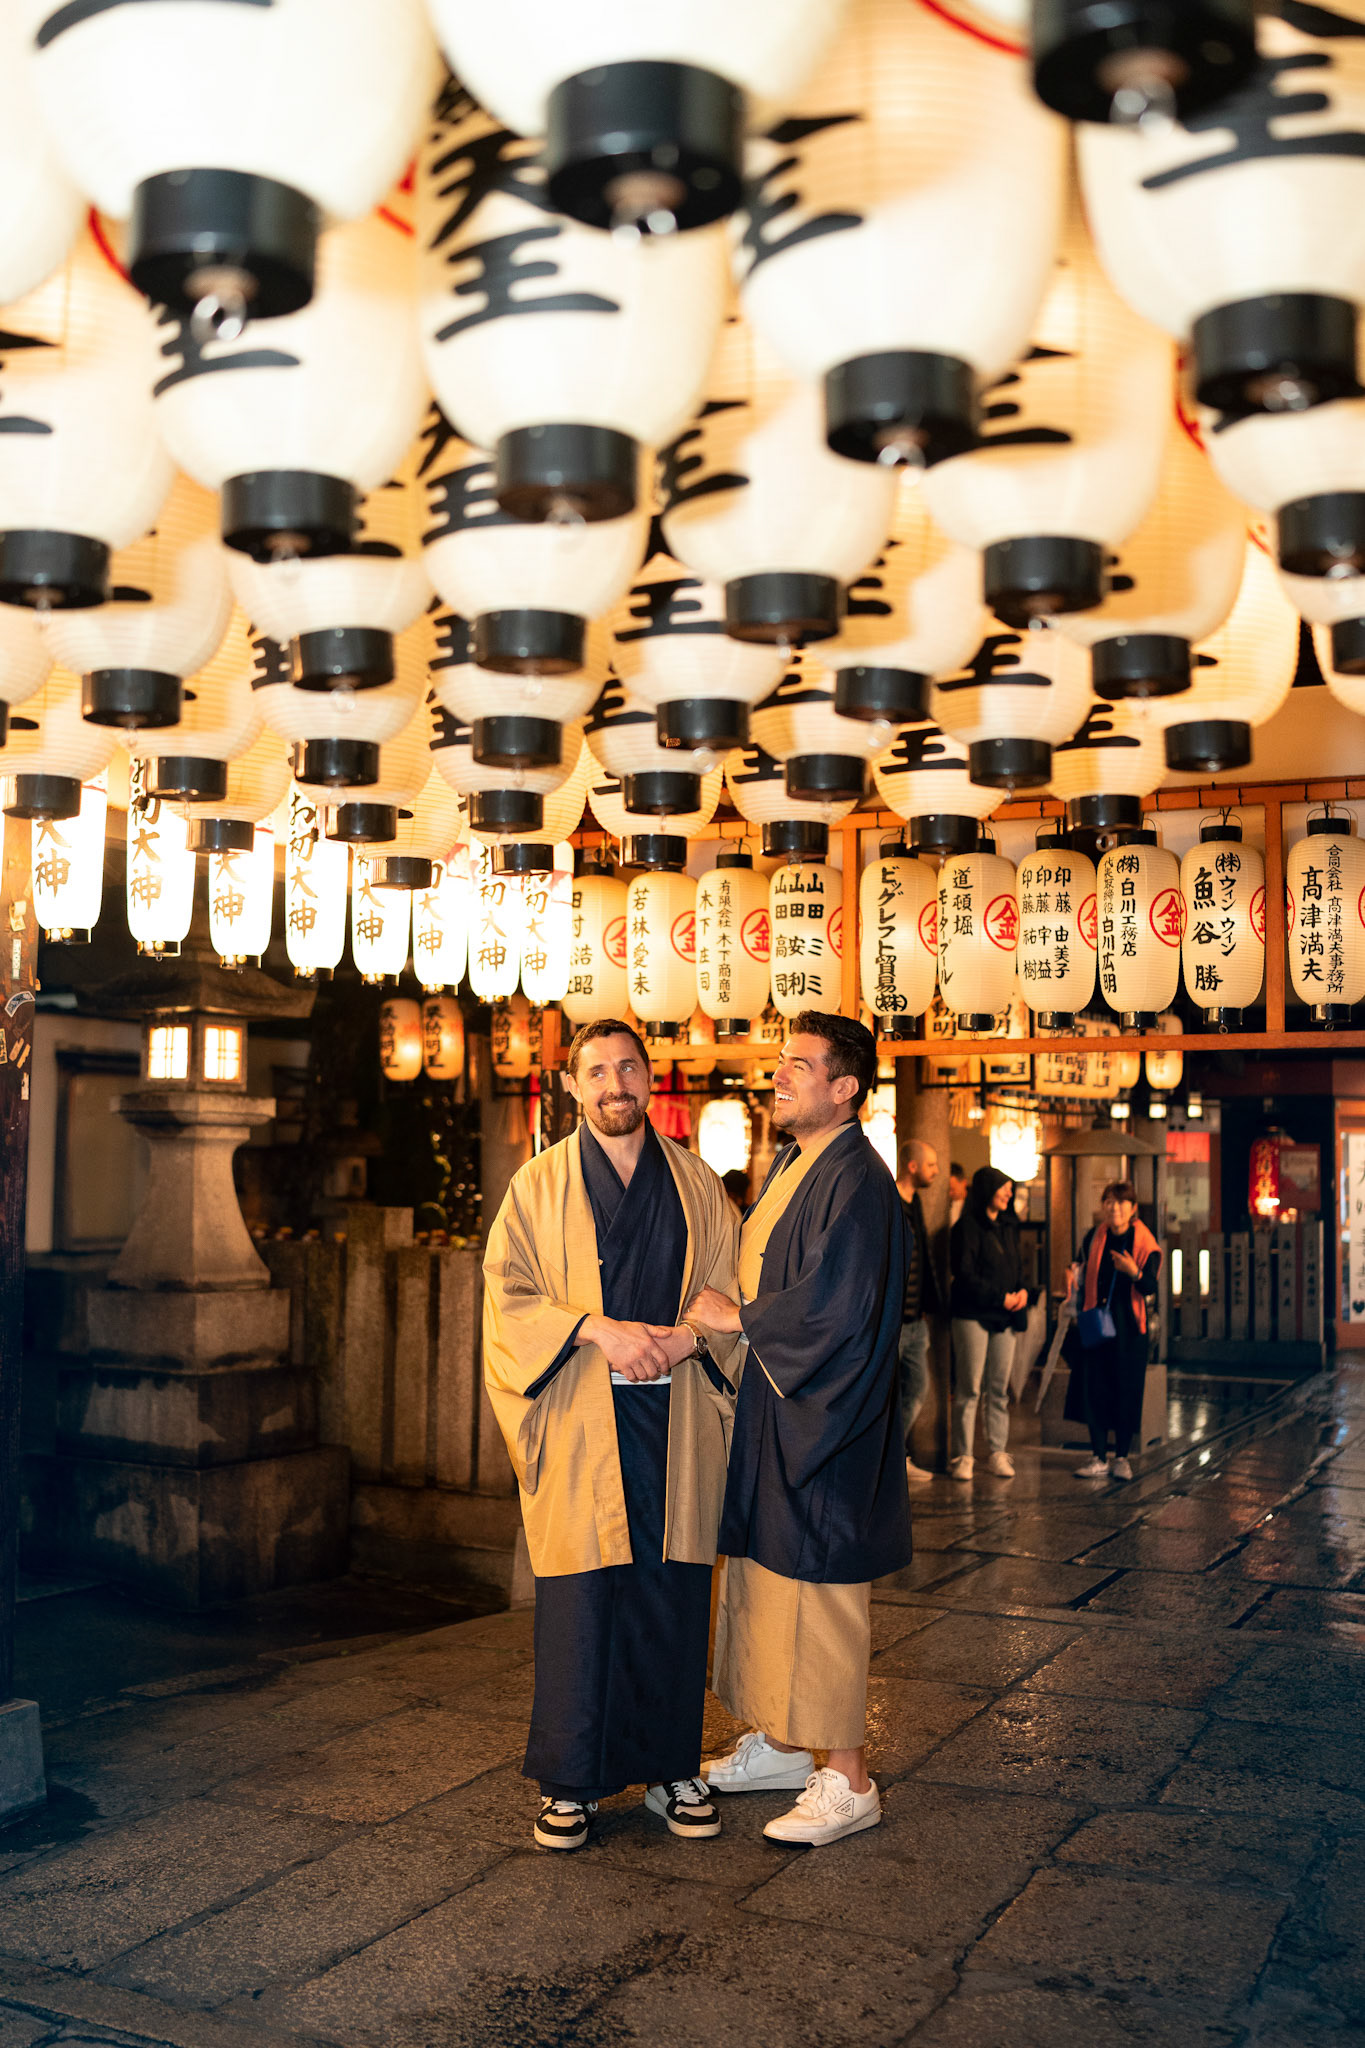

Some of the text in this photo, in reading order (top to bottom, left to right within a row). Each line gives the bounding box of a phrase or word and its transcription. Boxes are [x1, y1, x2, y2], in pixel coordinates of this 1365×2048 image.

[952, 866, 974, 936] 道頓堀
[990, 899, 1018, 941] 金
[1156, 894, 1185, 937] 金
[1191, 866, 1225, 992] 魚谷勝
